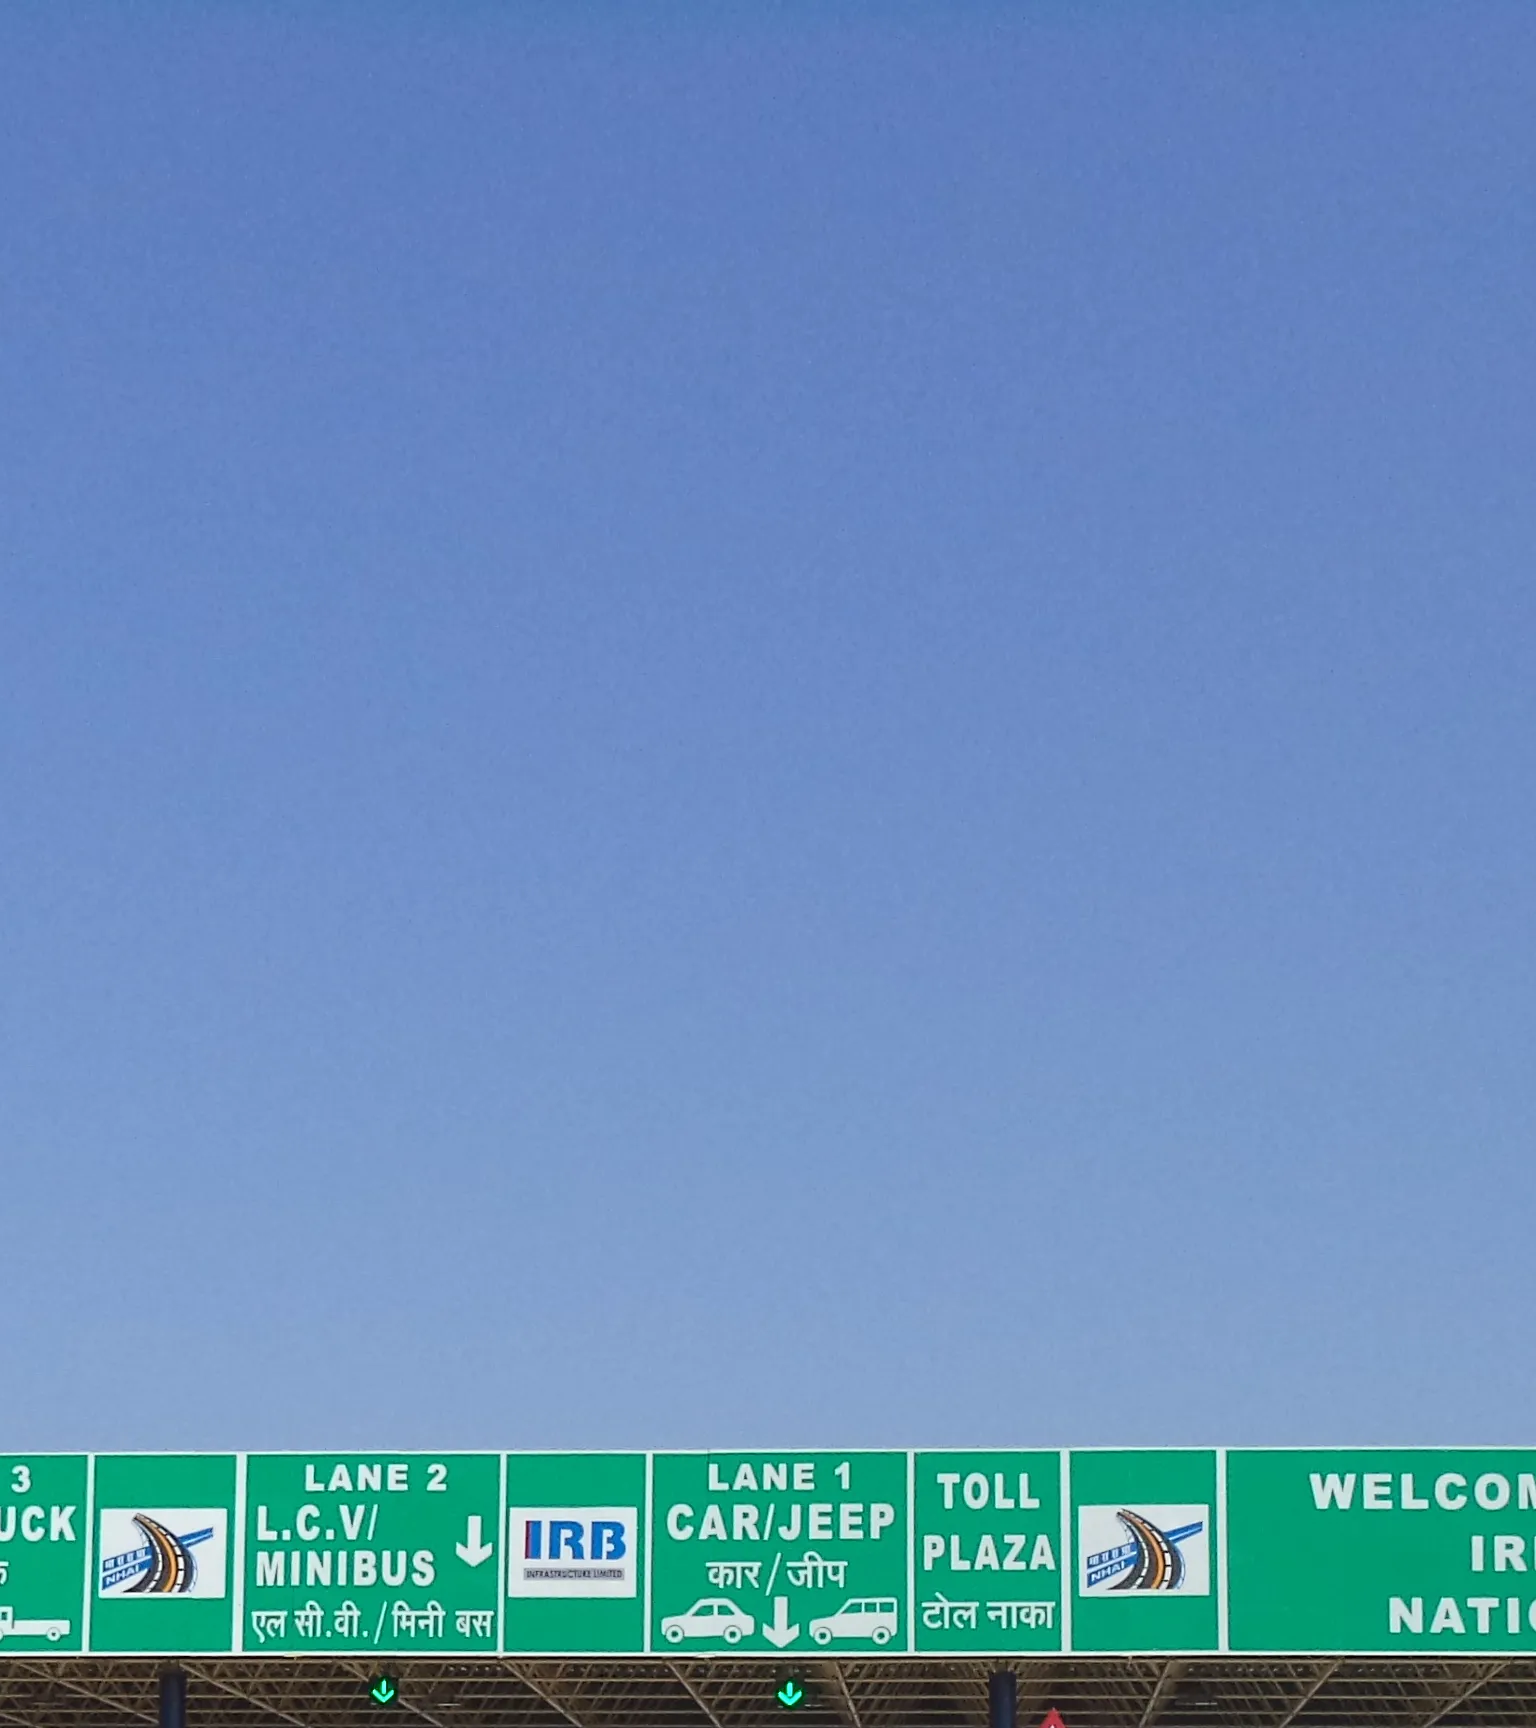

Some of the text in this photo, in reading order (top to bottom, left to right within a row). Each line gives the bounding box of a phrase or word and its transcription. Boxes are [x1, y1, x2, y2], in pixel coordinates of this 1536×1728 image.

[11, 1465, 31, 1493] 3
[305, 1463, 447, 1491] LANE 2
[708, 1462, 850, 1491] LANE 1
[937, 1472, 1040, 1509] TOLL
[257, 1504, 378, 1541] L.C.V/
[524, 1520, 626, 1560] IRB
[667, 1503, 895, 1541] CAR/JEEP
[256, 1550, 435, 1587] MINIBUS
[705, 1561, 762, 1589] कार
[786, 1551, 848, 1588] जीप
[923, 1534, 1056, 1571] PLAZA
[1090, 1560, 1125, 1582] NHAI
[105, 1563, 140, 1586] NHAI
[526, 1569, 623, 1579] INFRASTRUCTURE LIMITED
[251, 1610, 288, 1643] एल
[391, 1600, 446, 1638] मिनी
[455, 1610, 495, 1637] बस
[921, 1592, 1056, 1629] टोल नाका
